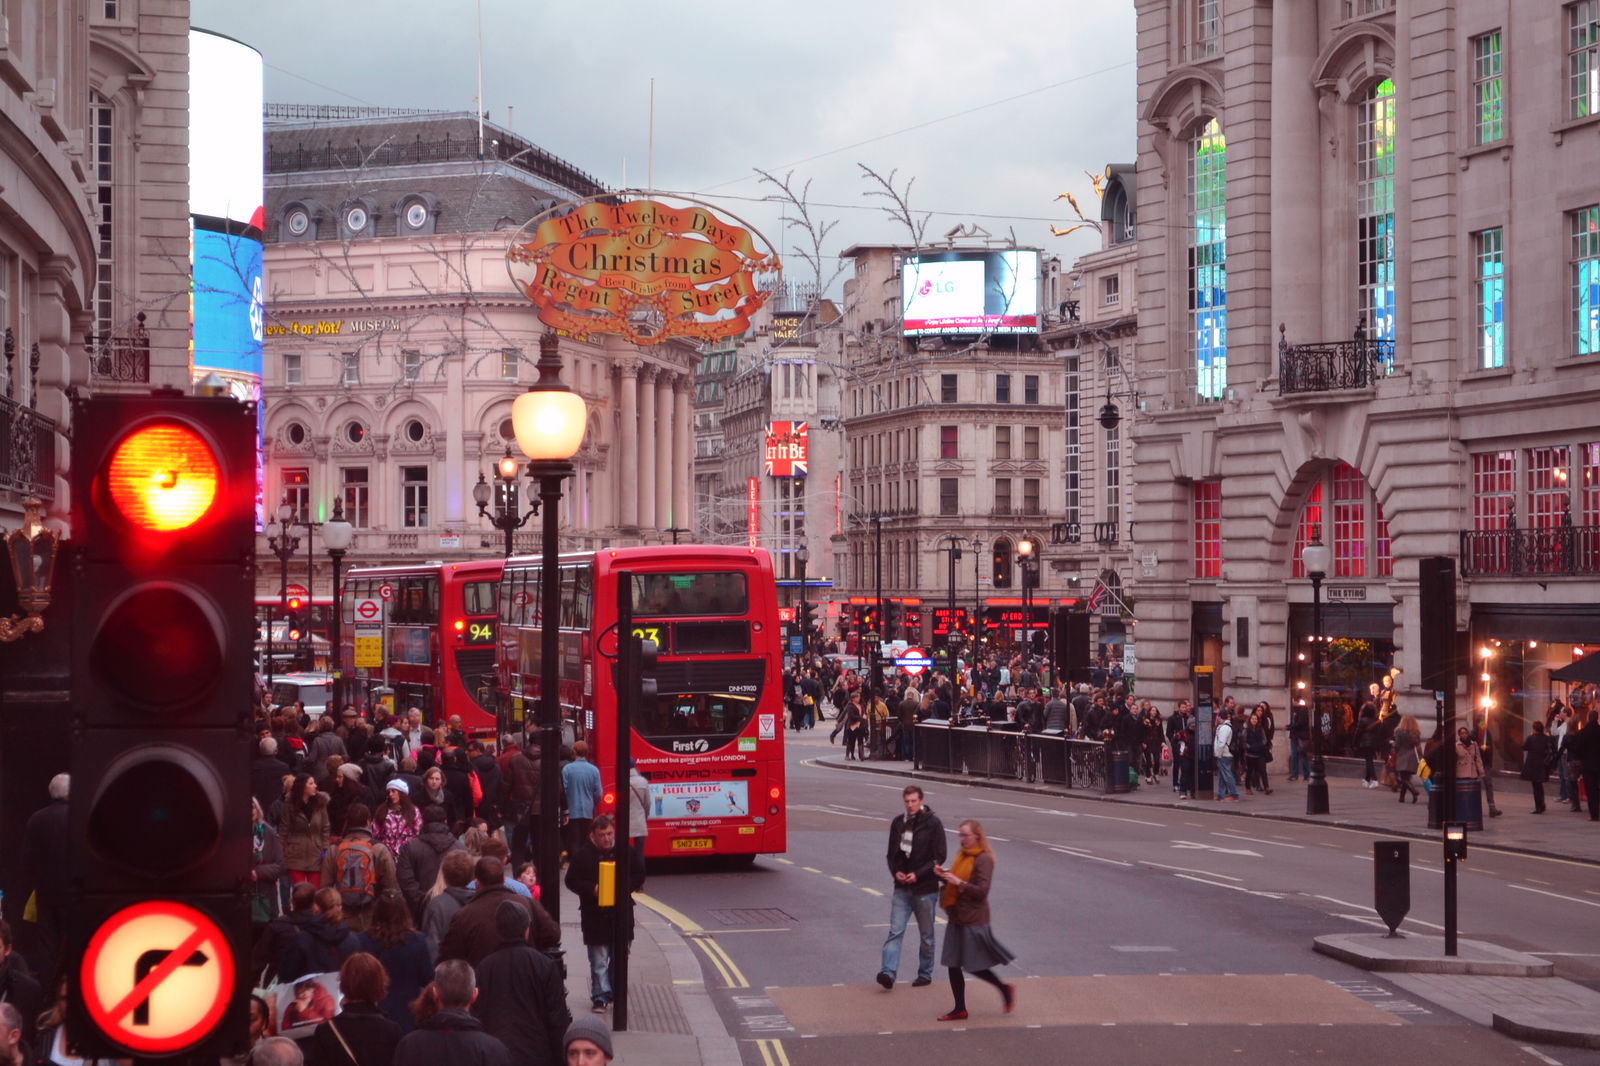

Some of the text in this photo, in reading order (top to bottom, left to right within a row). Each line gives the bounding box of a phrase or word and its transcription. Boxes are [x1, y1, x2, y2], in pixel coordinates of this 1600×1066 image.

[559, 206, 737, 249] The Twelve Days
[635, 228, 656, 245] of
[568, 242, 722, 276] Christmas
[540, 268, 742, 310] Regent Street
[606, 278, 625, 286] Best
[665, 279, 687, 289] from
[936, 281, 955, 293] LG
[301, 324, 314, 334] or
[315, 320, 343, 334] Not!
[350, 320, 399, 332] MUSEUM
[765, 443, 805, 459] LET IT BE
[381, 586, 391, 598] G
[470, 624, 492, 640] 94
[672, 741, 695, 752] First
[654, 770, 711, 779] ENVIRO
[663, 785, 721, 794] BULLDOG
